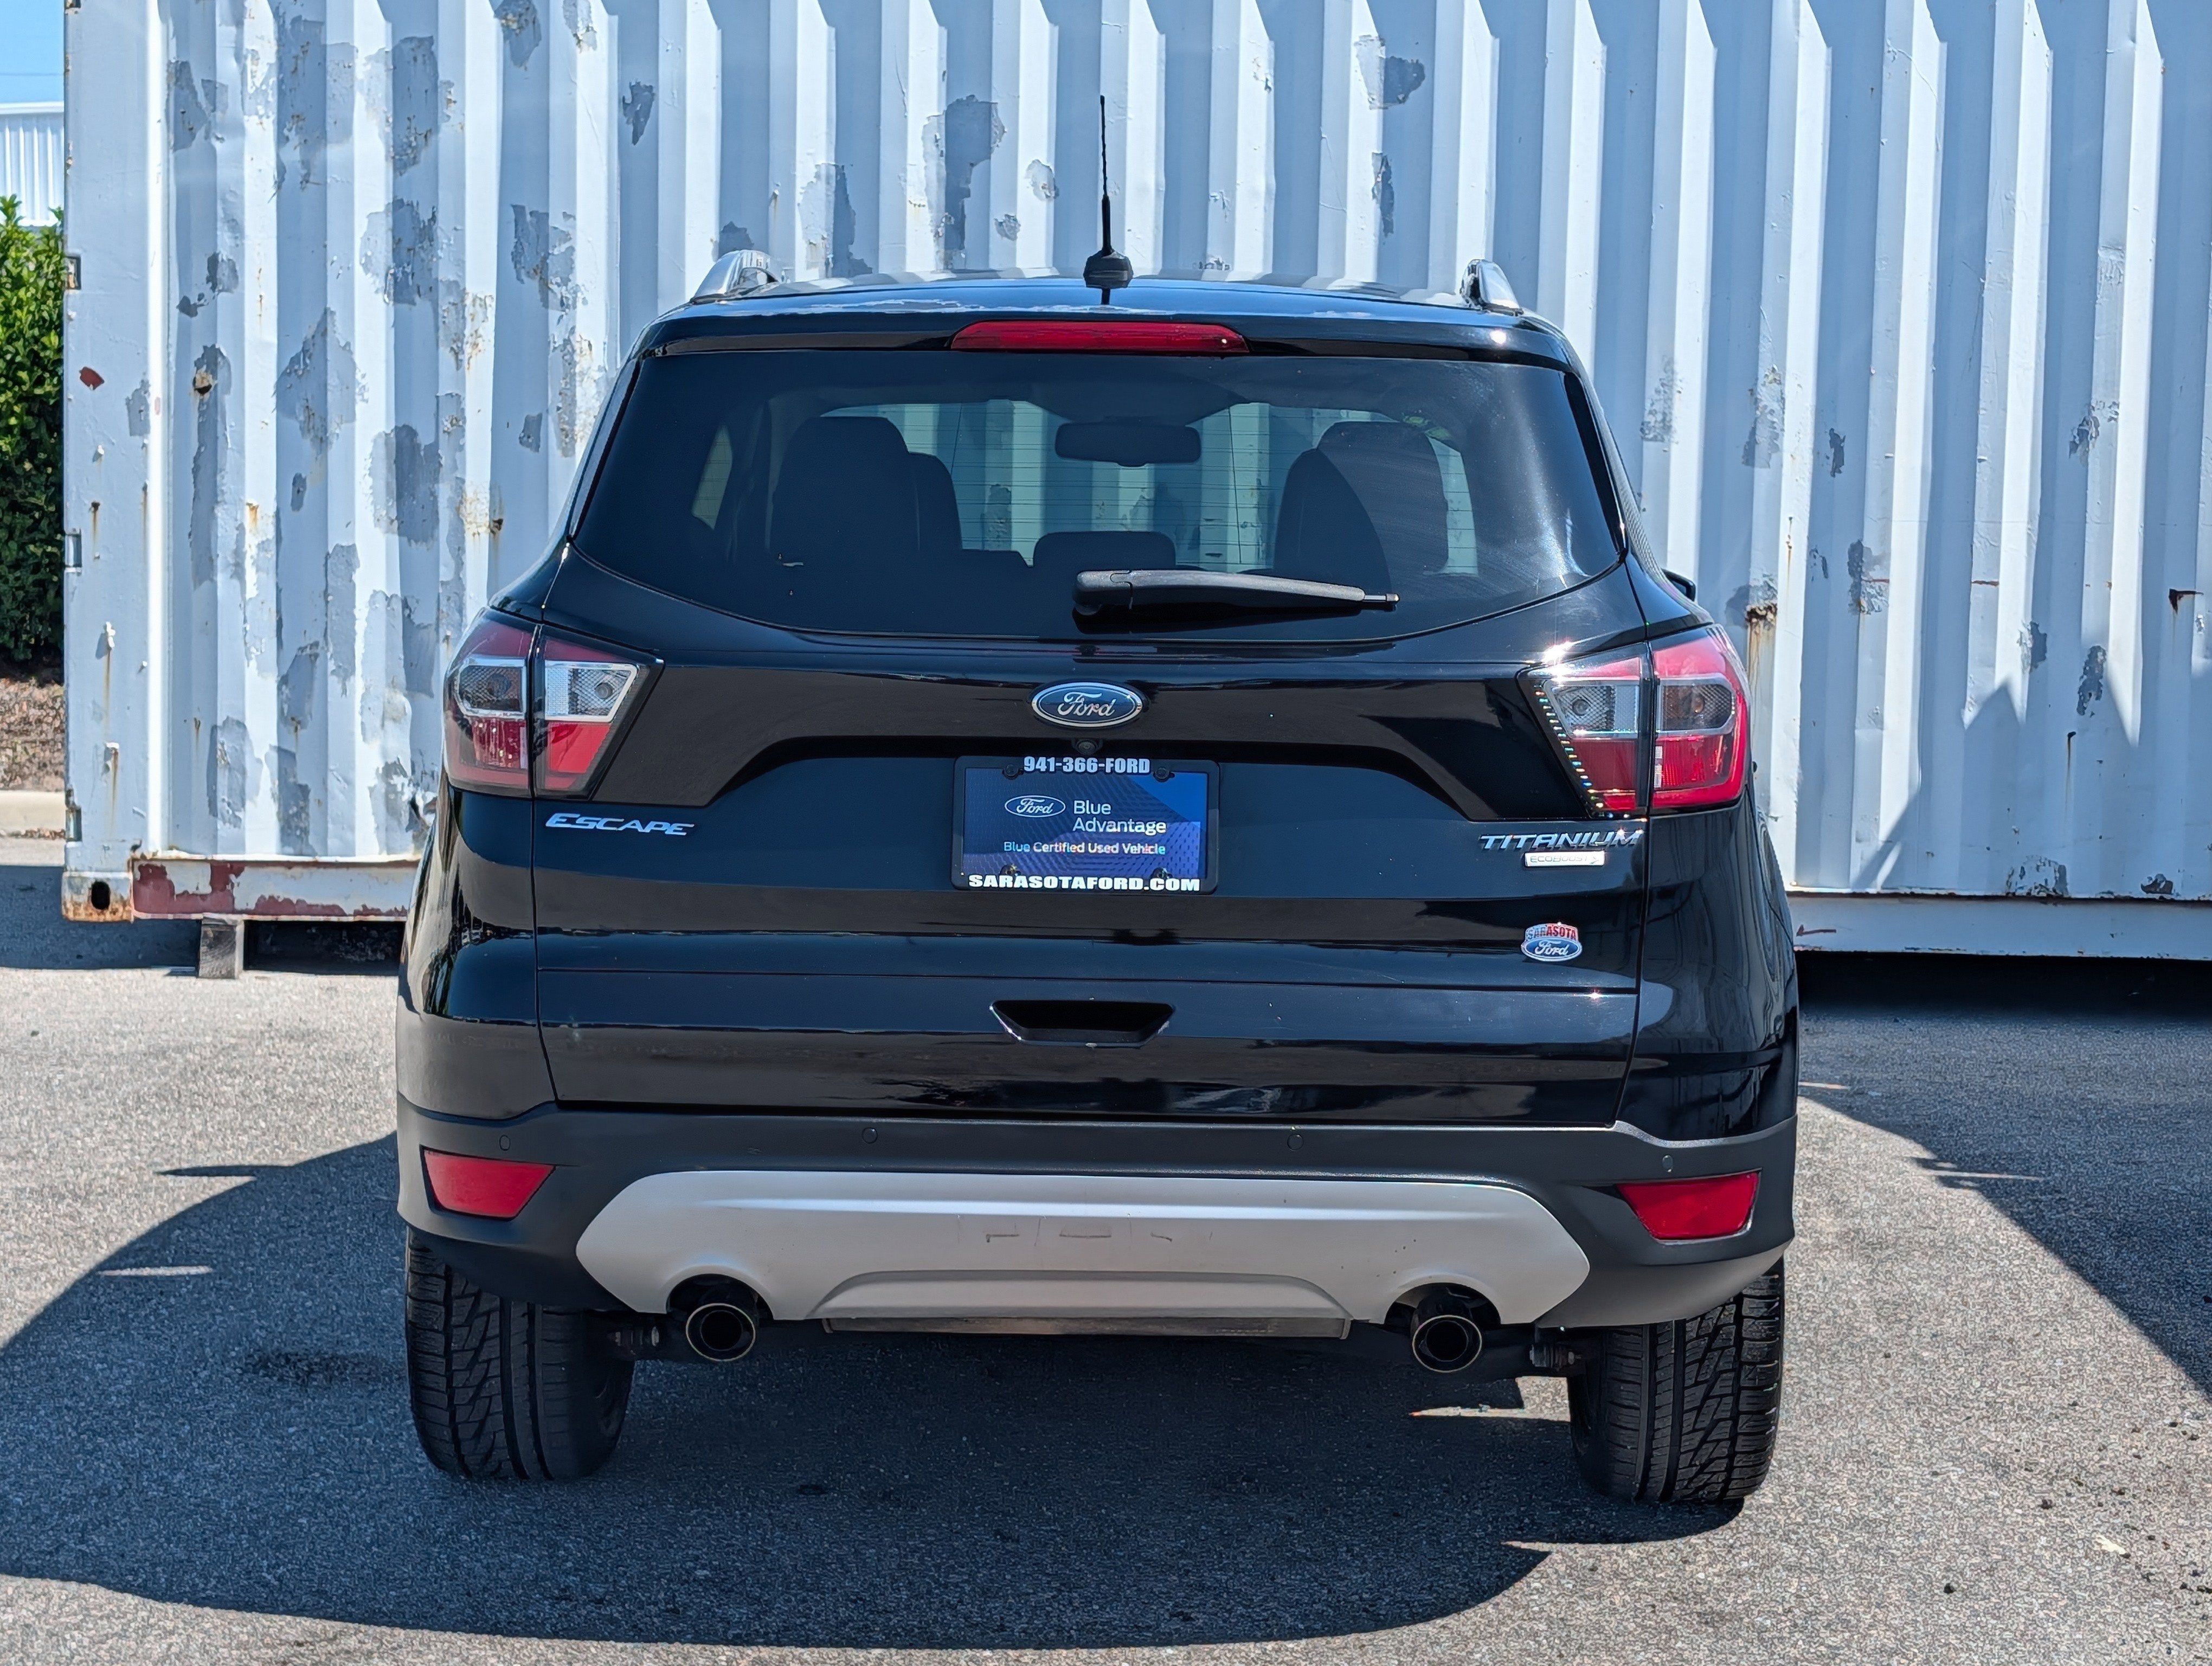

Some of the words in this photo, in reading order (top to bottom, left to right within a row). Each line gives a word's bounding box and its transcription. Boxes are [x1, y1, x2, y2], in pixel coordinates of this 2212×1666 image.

[1057, 691, 1115, 716] Ford
[1024, 756, 1150, 774] 941-366-FORD
[1016, 798, 1054, 814] Ford
[1073, 800, 1111, 815] Blue
[545, 813, 695, 836] ESCAPE
[1072, 817, 1167, 836] Advantage
[1004, 841, 1030, 853] Blue
[1033, 842, 1085, 853] Certified
[1088, 842, 1119, 854] Used
[1122, 843, 1166, 855] Vehicle
[1480, 829, 1644, 849] TITANIUM
[968, 874, 1201, 892] SARASOTAFORD.COM
[1527, 926, 1576, 941] SARASOTA
[1534, 940, 1570, 955] Ford
